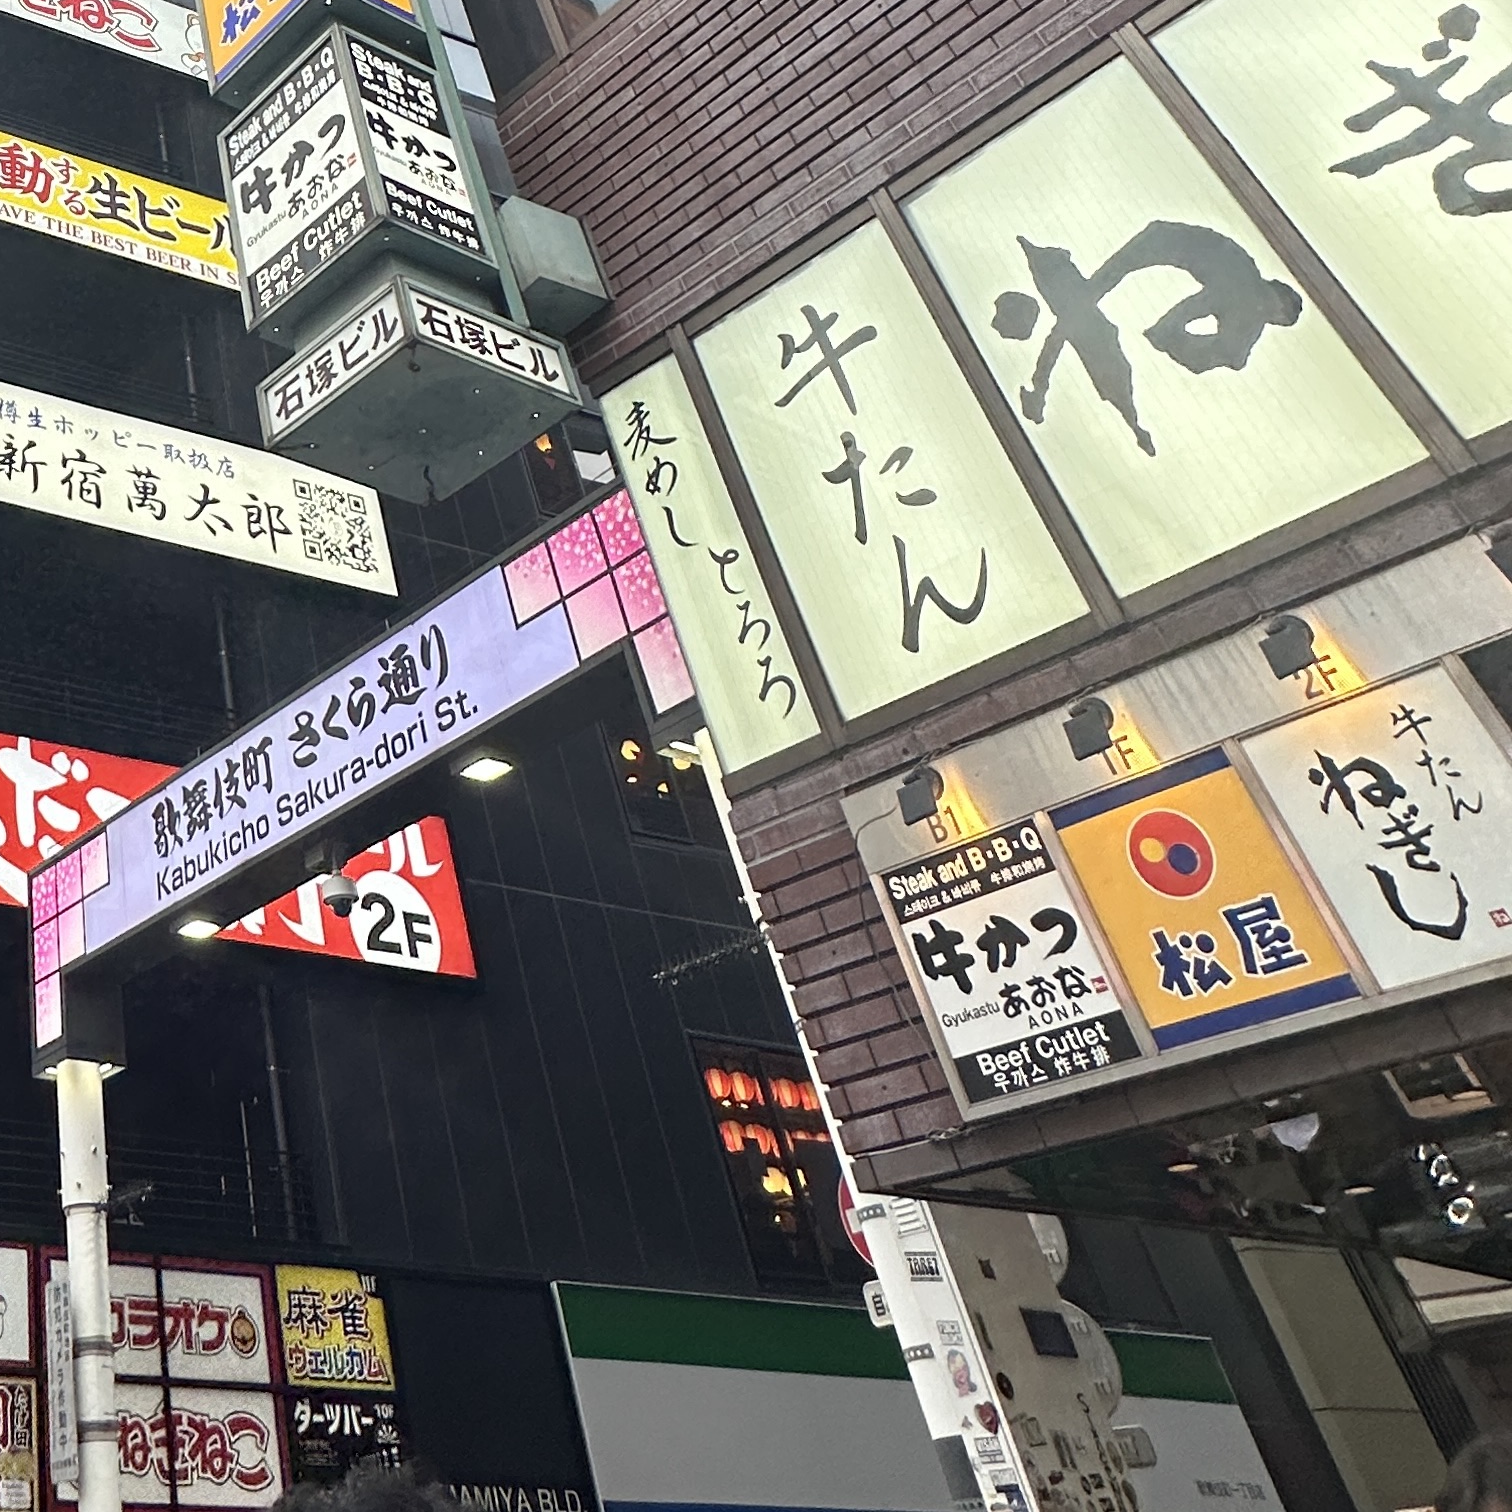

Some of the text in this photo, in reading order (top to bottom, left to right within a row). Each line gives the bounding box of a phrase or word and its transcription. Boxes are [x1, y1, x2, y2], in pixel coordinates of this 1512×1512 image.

[350, 41, 433, 94] Steak and
[228, 121, 262, 155] Steak
[262, 99, 284, 133] and
[366, 108, 457, 173] 牛かつ
[240, 113, 346, 215] 牛かつ
[288, 153, 347, 219] あおな
[408, 158, 457, 192] あおな
[302, 183, 339, 221] AONA
[384, 180, 475, 232] Beef Cutlet
[45, 214, 85, 241] THE
[90, 228, 140, 256] BEST
[145, 244, 193, 274] BEER
[200, 261, 220, 281] IN
[255, 190, 363, 291] Beef Cutlet
[318, 213, 366, 263] 炸牛排
[273, 308, 399, 420] 石塚ビル
[416, 299, 559, 382] 石塚ビル
[774, 303, 989, 656] 牛たん
[623, 399, 799, 720] 麦めしとろろ
[1300, 653, 1340, 698] 2F
[152, 736, 274, 859] 歌舞伎町
[288, 624, 451, 769] さくら通り
[1389, 702, 1484, 823] 牛たん
[156, 813, 271, 901] Kabukicho
[276, 712, 429, 823] Sakura-dori
[434, 687, 480, 738] St.
[926, 804, 963, 844] B1
[888, 859, 938, 902] Steak
[935, 851, 969, 882] and
[1307, 749, 1470, 941] ねぎし
[359, 893, 434, 961] 2F
[912, 905, 1080, 996] 牛かつ
[1147, 893, 1313, 1000] 松屋
[941, 999, 1001, 1032] Gyukastu
[1001, 965, 1093, 1021] あおな
[1028, 1001, 1085, 1031] AONA
[977, 1019, 1112, 1077] Beef Cutlet
[992, 1044, 1112, 1094] 우까스 炸牛排
[284, 1286, 371, 1342] 麻雀
[118, 1410, 274, 1492] ねきねこ
[449, 1484, 532, 1512] AMIYA
